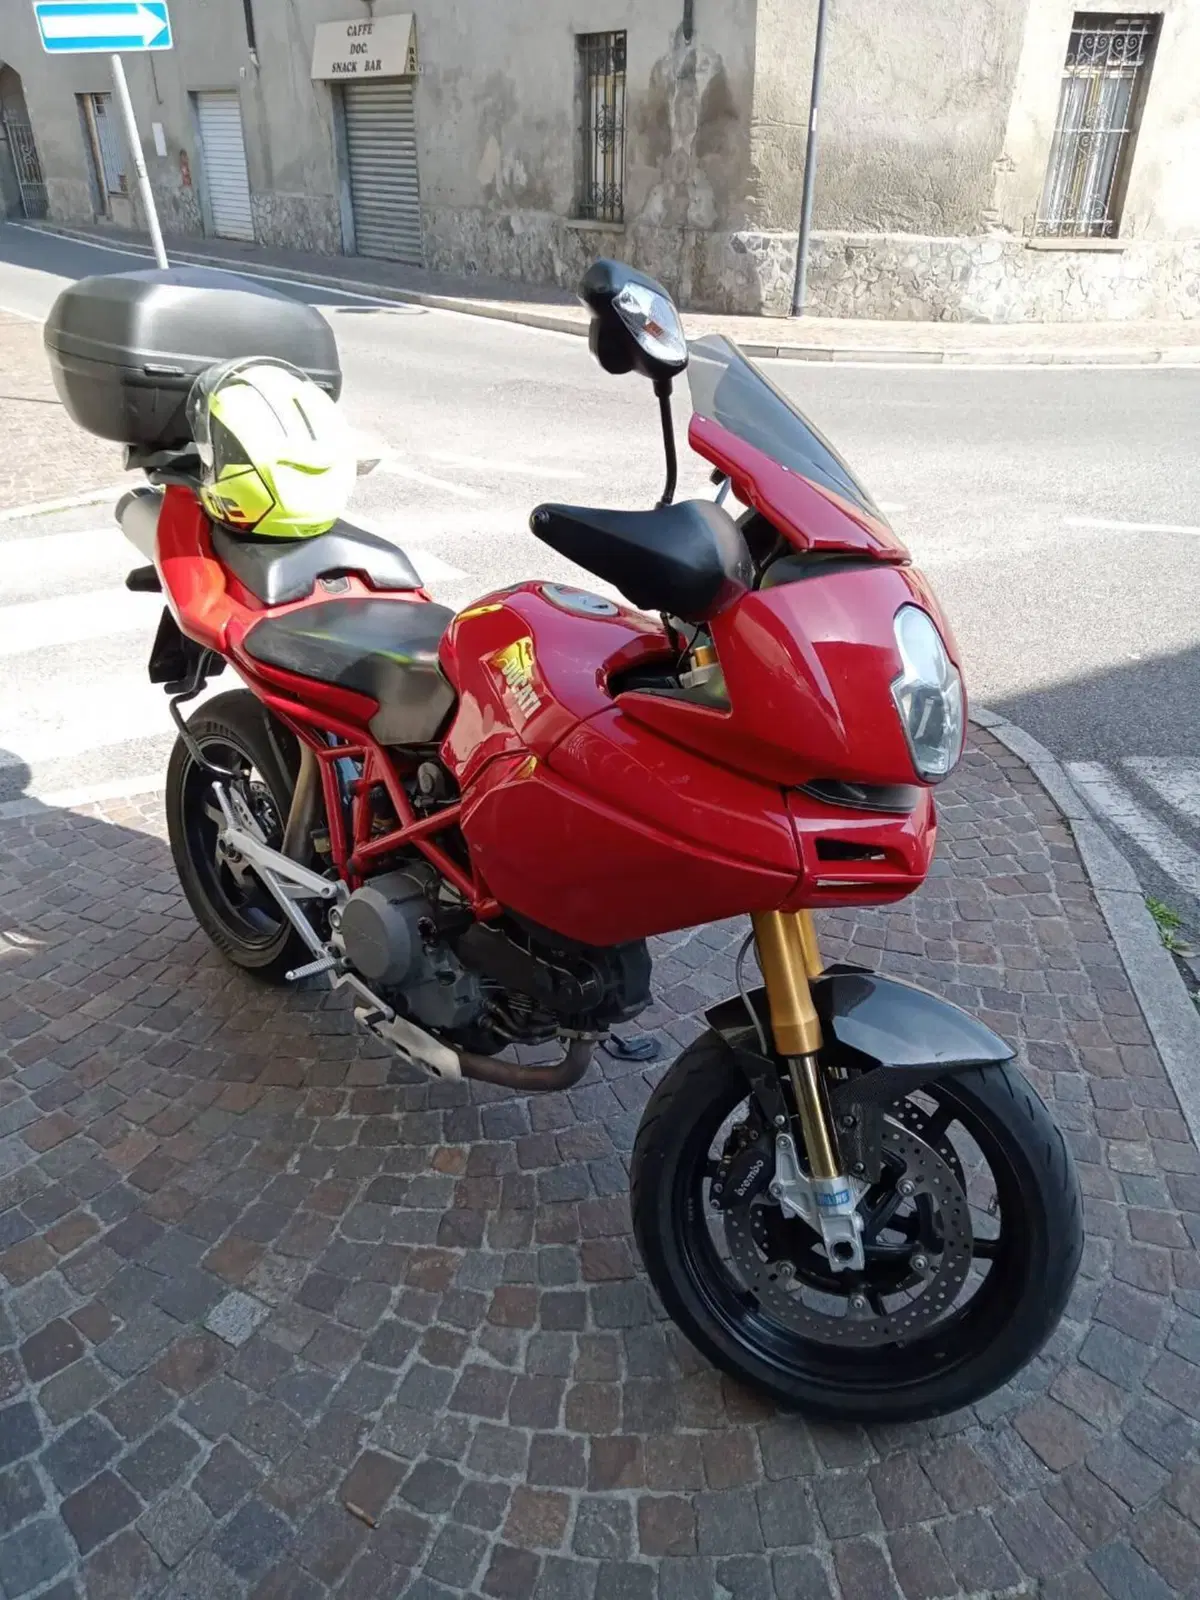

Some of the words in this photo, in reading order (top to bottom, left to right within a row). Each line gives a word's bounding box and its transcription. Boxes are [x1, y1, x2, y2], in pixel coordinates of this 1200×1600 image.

[331, 61, 358, 73] SNACK
[364, 59, 382, 72] BAR
[501, 657, 541, 719] DUCATI
[733, 1159, 764, 1197] brembo
